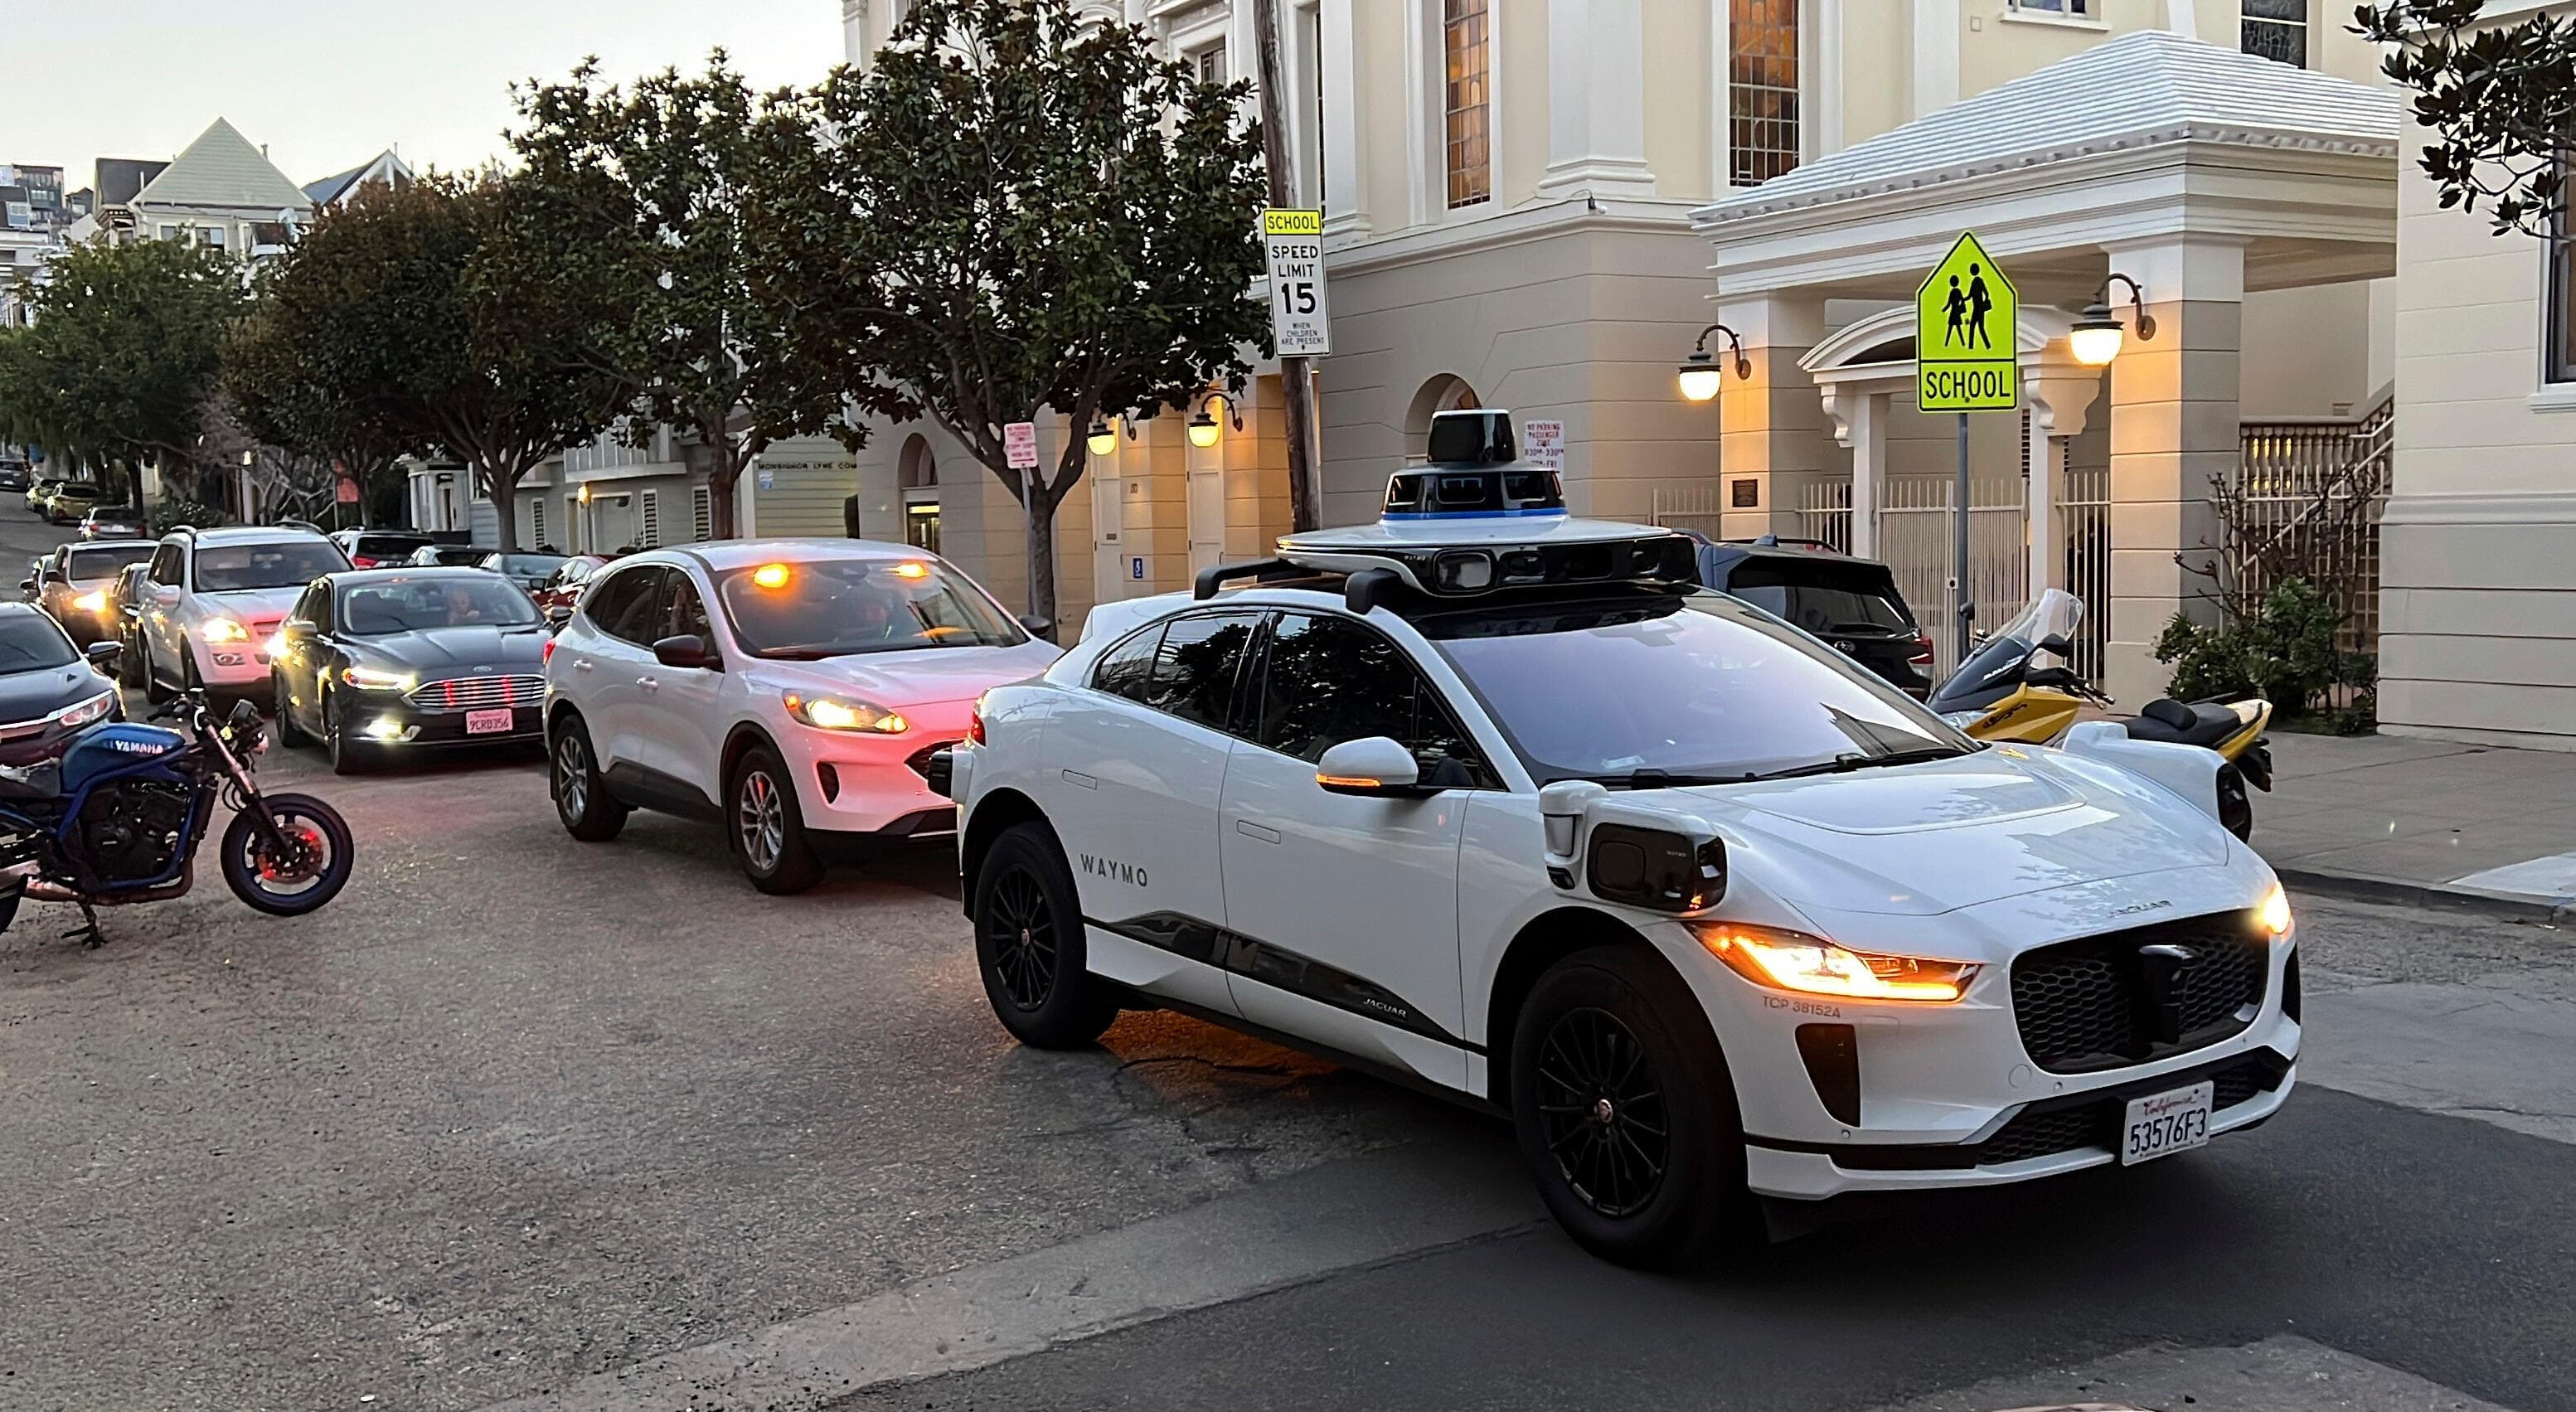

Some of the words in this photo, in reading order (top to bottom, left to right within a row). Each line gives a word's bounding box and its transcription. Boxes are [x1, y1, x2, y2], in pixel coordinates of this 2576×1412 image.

[1268, 216, 1318, 230] SCHOOL
[1272, 245, 1318, 259] SPEED
[1278, 264, 1314, 278] LIMIT
[1281, 282, 1316, 314] 15
[1297, 337, 1324, 345] PRESENT
[1925, 371, 2011, 399] SCHOOL
[114, 740, 163, 755] YAMAHA
[1080, 854, 1147, 887] WAYMO
[1363, 998, 1407, 1018] JAGUAR
[1763, 996, 1789, 1008] TCP
[1793, 1002, 1841, 1019] 38152A
[2129, 1107, 2207, 1155] 53576F3
